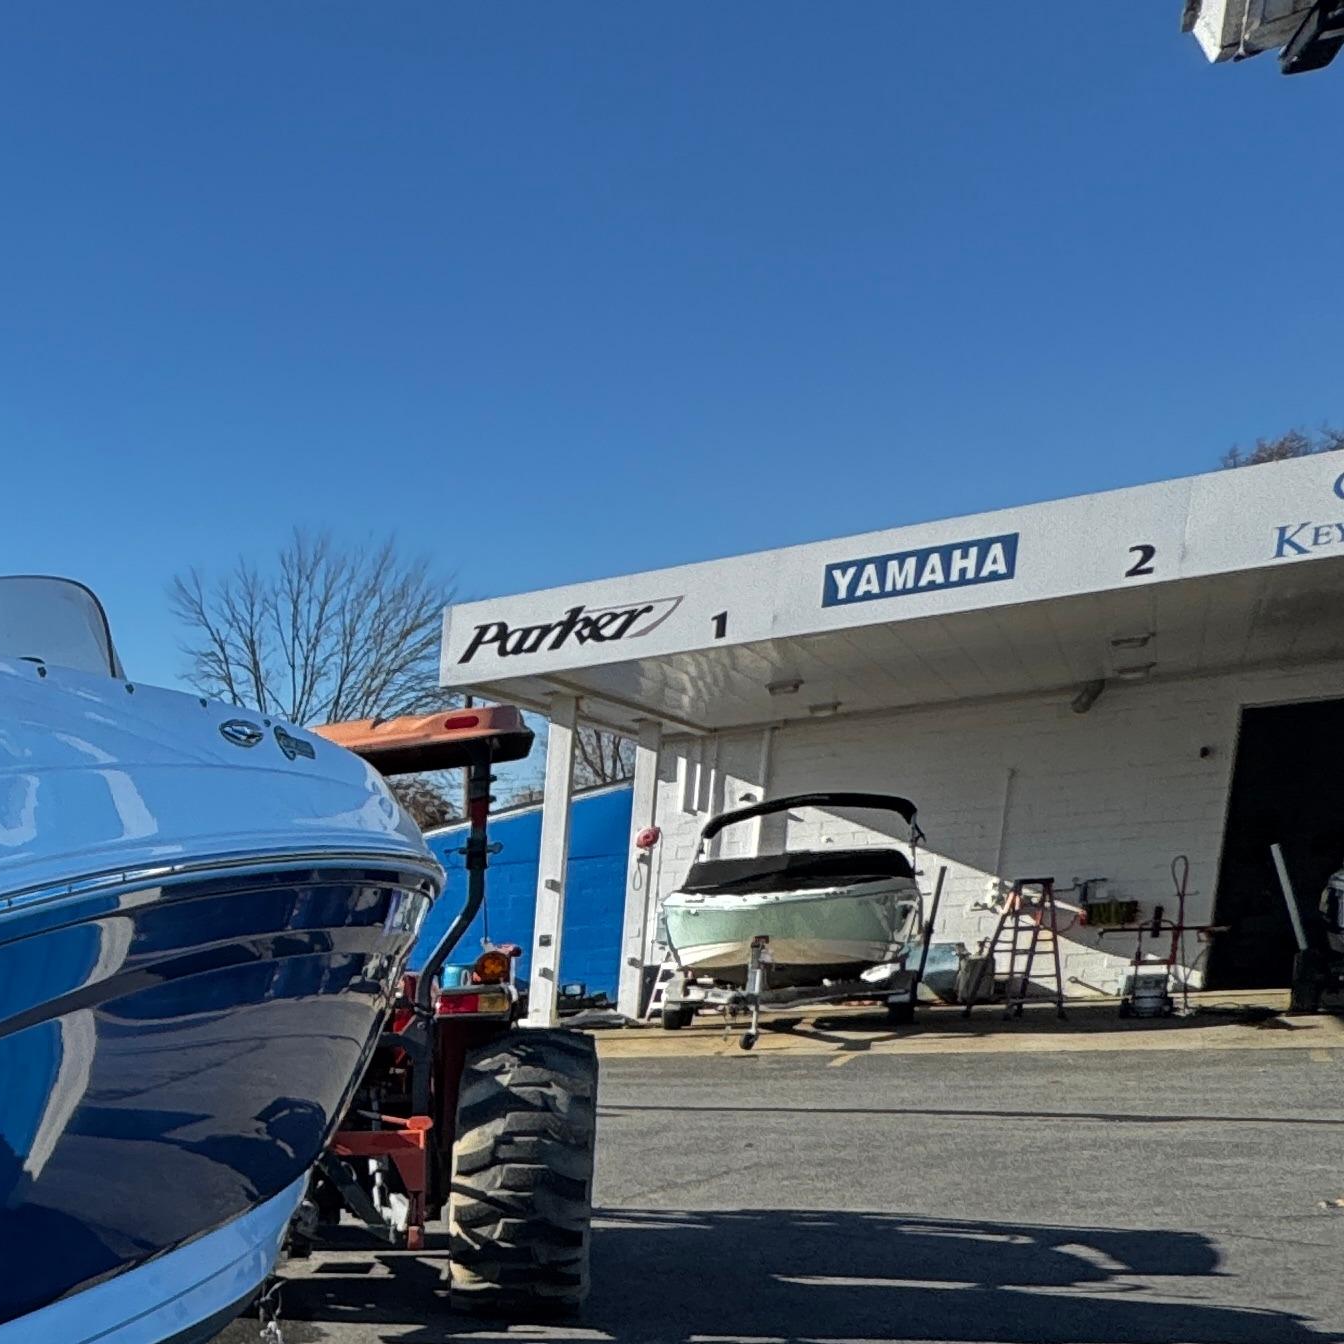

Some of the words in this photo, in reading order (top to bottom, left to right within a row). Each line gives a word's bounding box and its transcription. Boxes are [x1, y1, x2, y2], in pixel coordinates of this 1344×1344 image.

[831, 542, 1008, 600] YAMAHA
[1125, 544, 1157, 578] 2
[457, 605, 654, 665] Parker
[711, 611, 728, 639] 1
